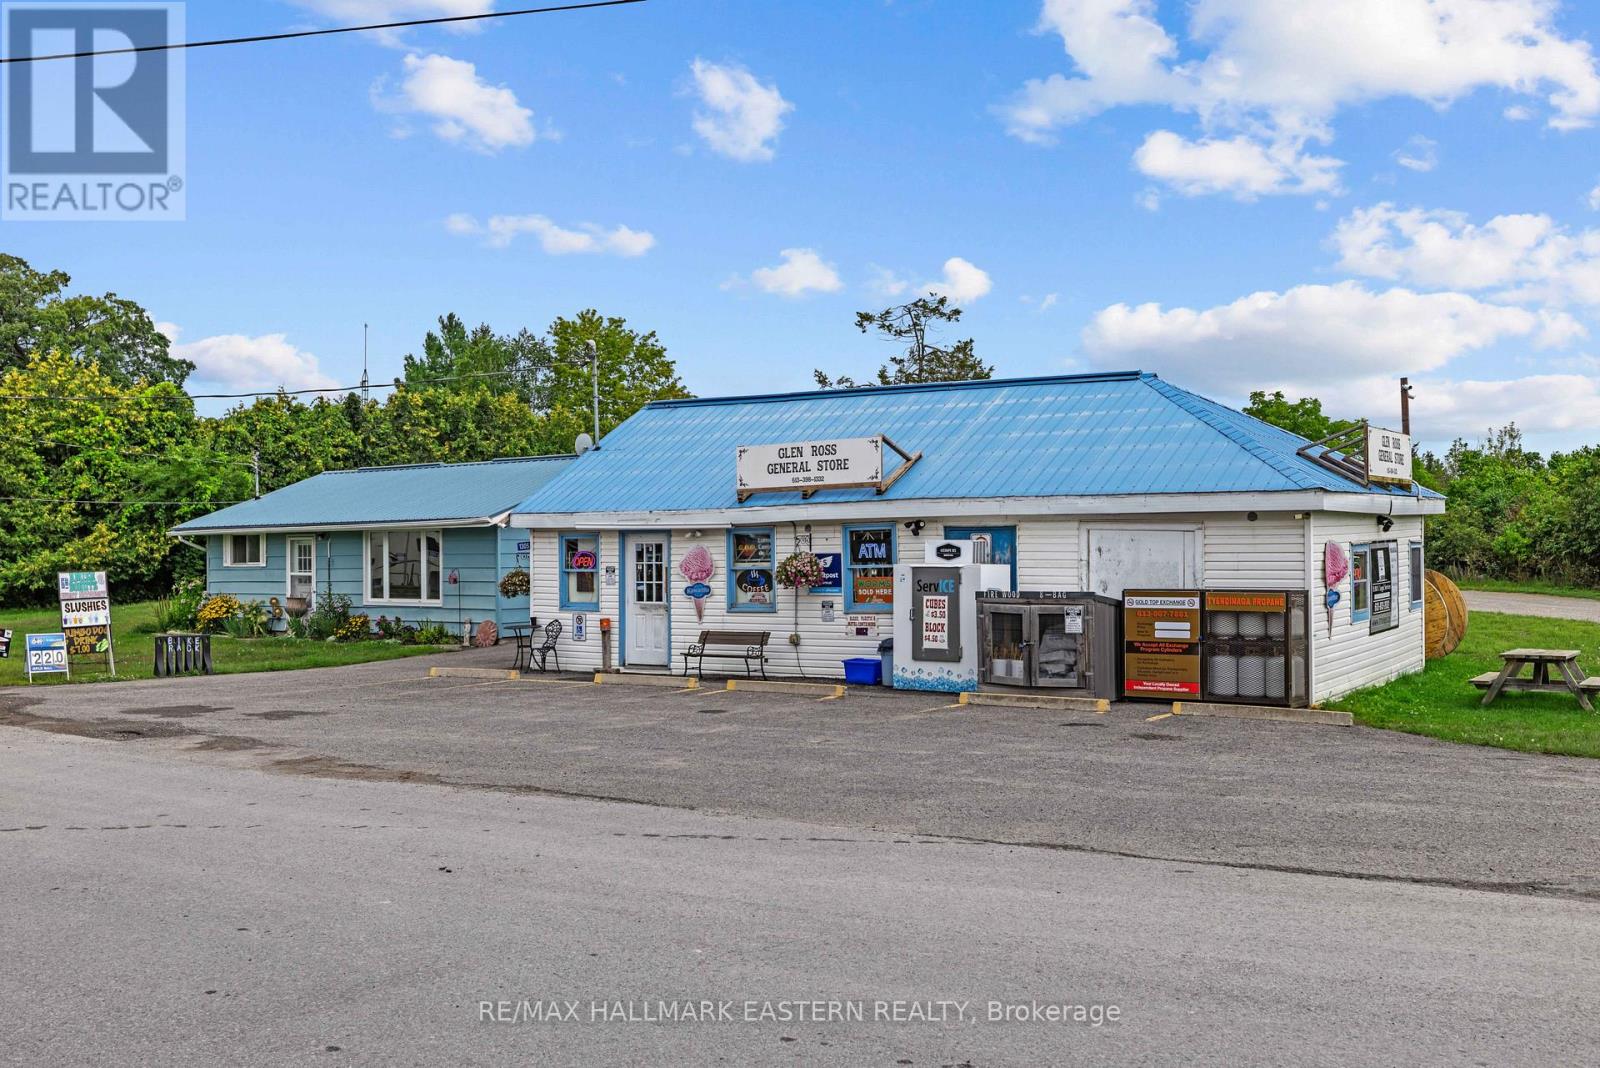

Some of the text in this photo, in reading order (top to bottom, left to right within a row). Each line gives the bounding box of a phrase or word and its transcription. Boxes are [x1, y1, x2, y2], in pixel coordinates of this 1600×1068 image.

[778, 444, 837, 459] GLEN ROSS
[767, 458, 850, 475] GENERAL STORE
[858, 543, 887, 559] ATM
[574, 556, 594, 567] OPEN
[916, 579, 955, 593] ServICE
[858, 588, 893, 596] SOLD HERE
[983, 591, 998, 599] FIRE
[1002, 591, 1020, 599] WOOD
[64, 600, 107, 613] SLUSHIES
[925, 599, 946, 609] CUBES
[930, 610, 946, 619] $3.50
[925, 622, 946, 633] BLOCK
[167, 636, 200, 645] BIKE
